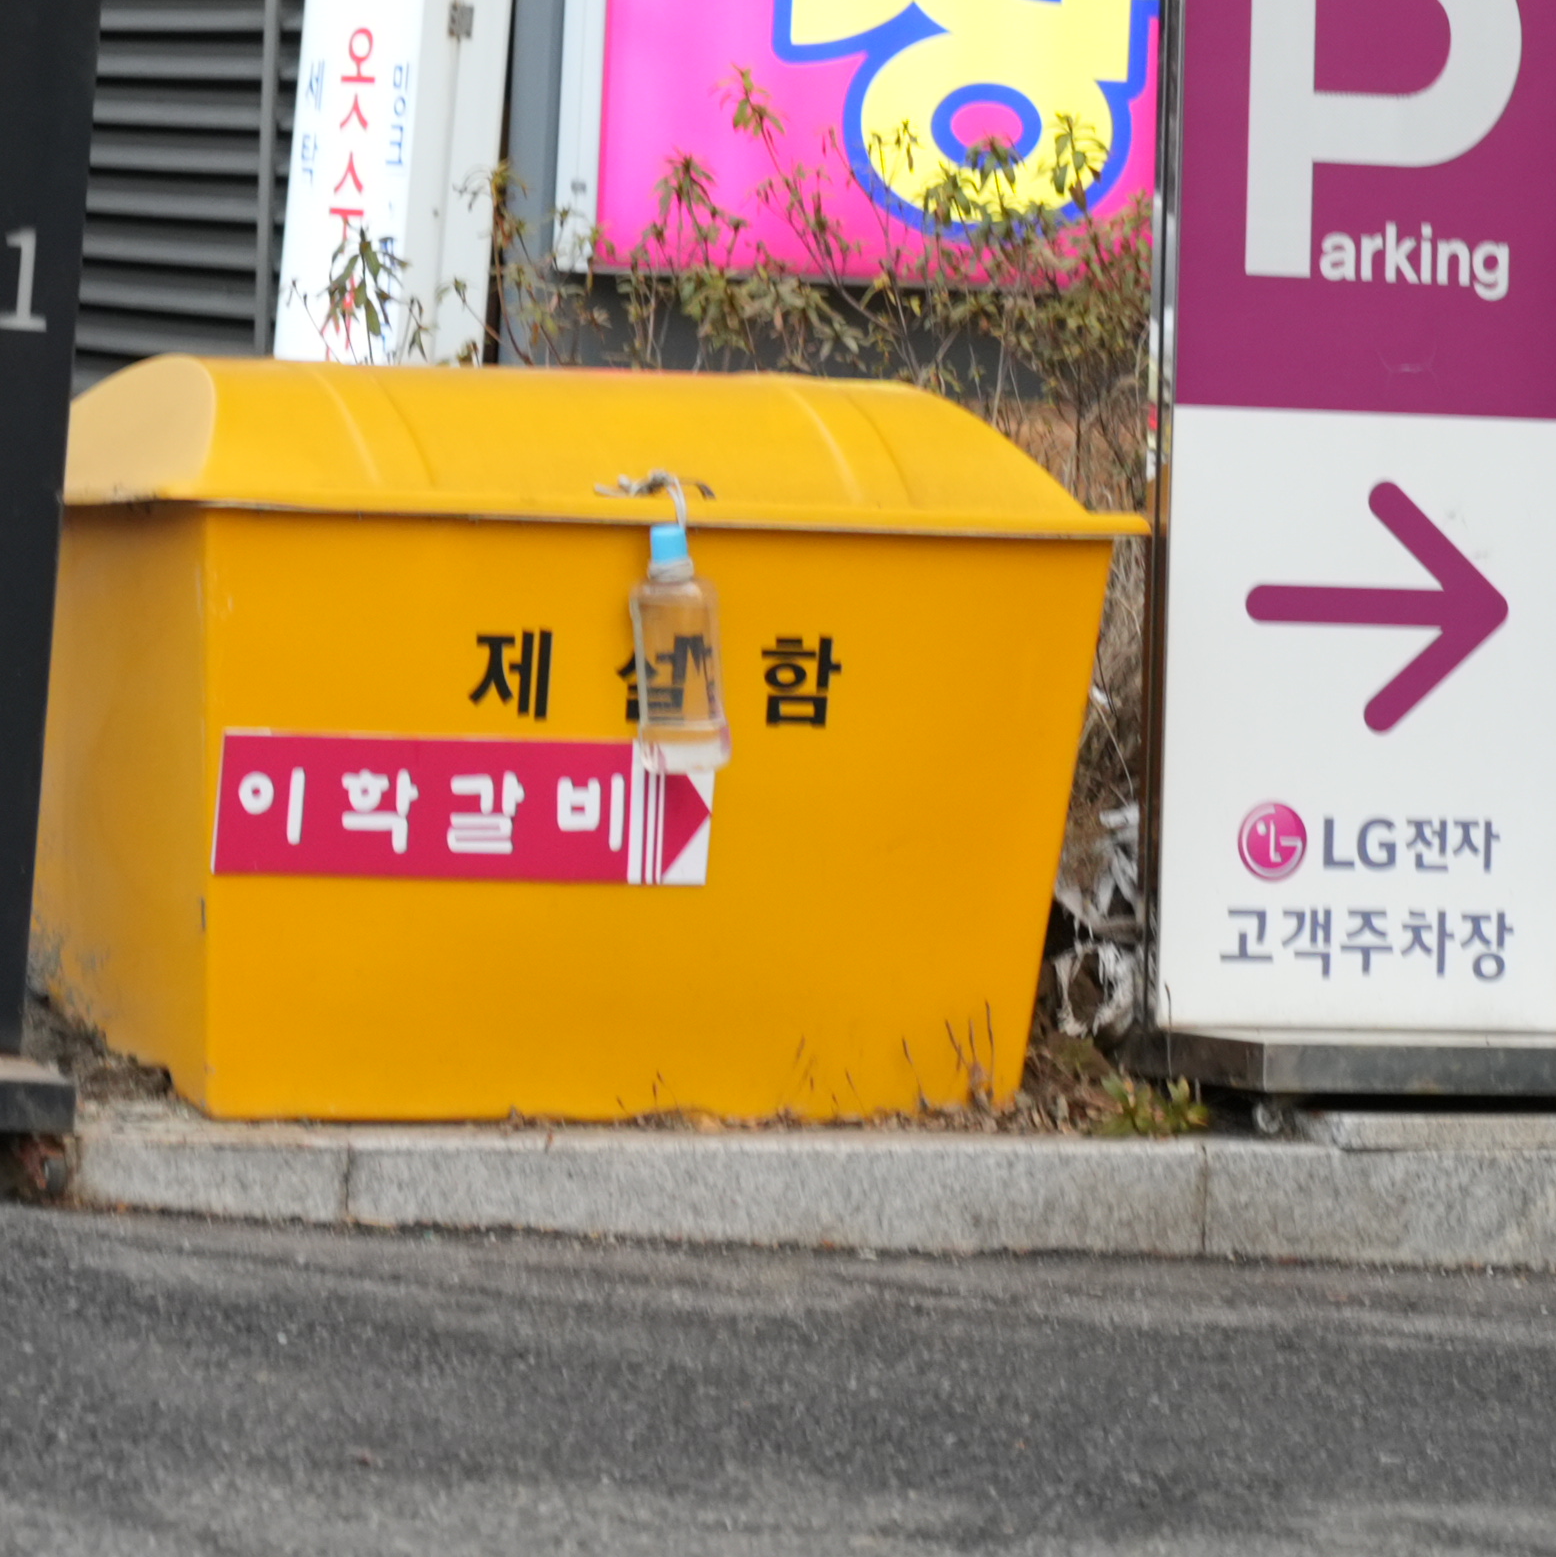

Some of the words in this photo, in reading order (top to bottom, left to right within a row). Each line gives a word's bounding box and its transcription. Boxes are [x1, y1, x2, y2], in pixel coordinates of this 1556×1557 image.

[237, 767, 626, 855] 이학갈비
[1322, 814, 1501, 874] LG전자
[1219, 906, 1515, 983] 고객주차장
